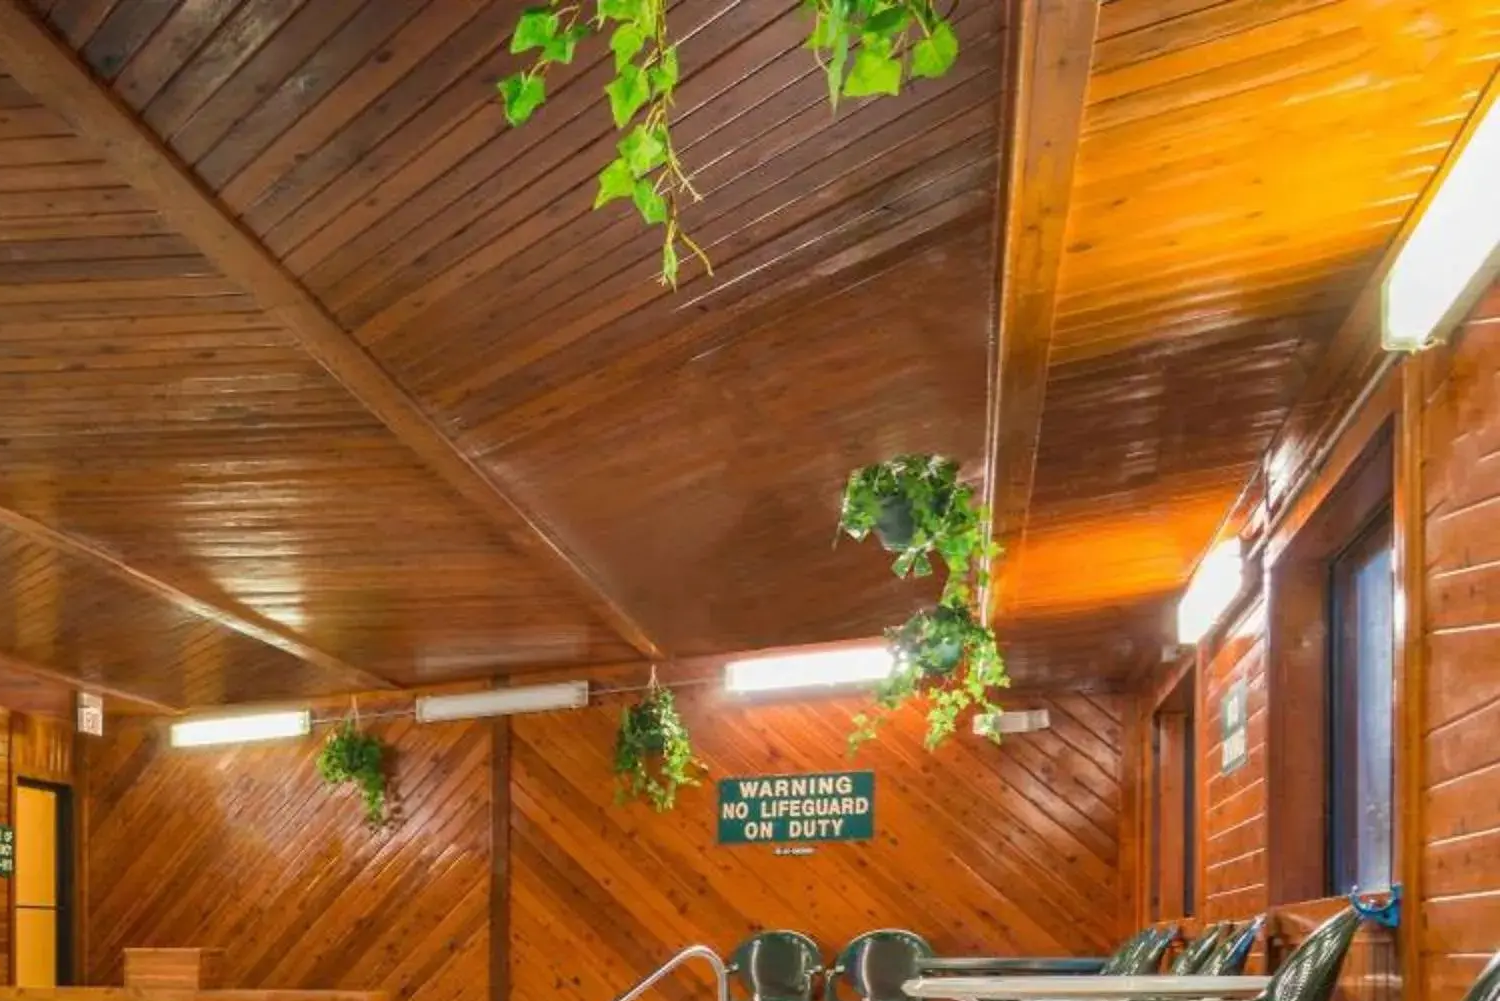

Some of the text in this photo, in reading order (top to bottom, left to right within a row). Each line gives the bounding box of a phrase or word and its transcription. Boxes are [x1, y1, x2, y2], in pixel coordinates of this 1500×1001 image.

[739, 776, 853, 798] WARNING
[722, 797, 869, 820] NO LIFEGUARD
[744, 819, 844, 840] ON DUTY
